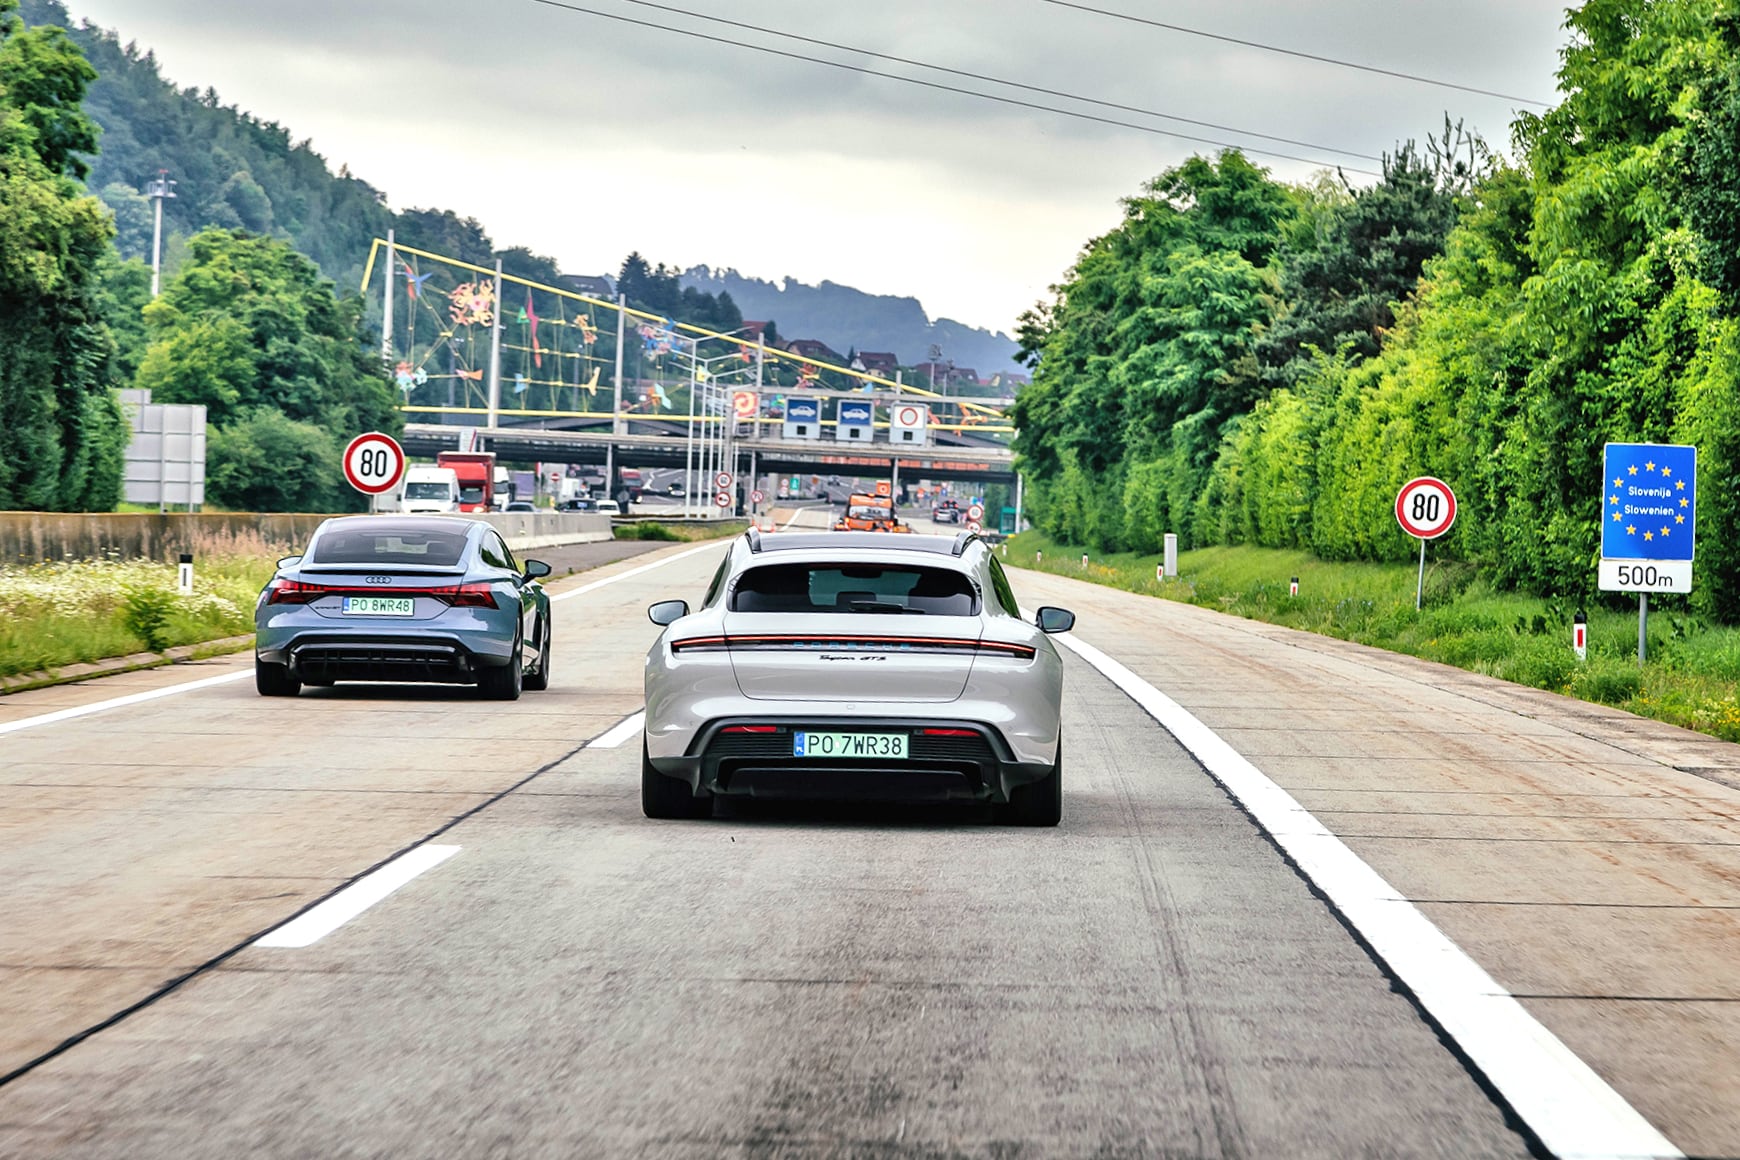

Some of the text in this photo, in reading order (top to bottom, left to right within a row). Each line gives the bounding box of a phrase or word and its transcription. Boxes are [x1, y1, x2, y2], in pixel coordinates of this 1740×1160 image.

[361, 448, 388, 478] 80
[1628, 486, 1672, 499] Slovenija
[1412, 493, 1440, 522] 80
[1624, 504, 1675, 516] Slowenien
[1618, 565, 1673, 587] 500m
[351, 599, 410, 612] PO 8WR48
[808, 735, 902, 755] PO 7WR38
